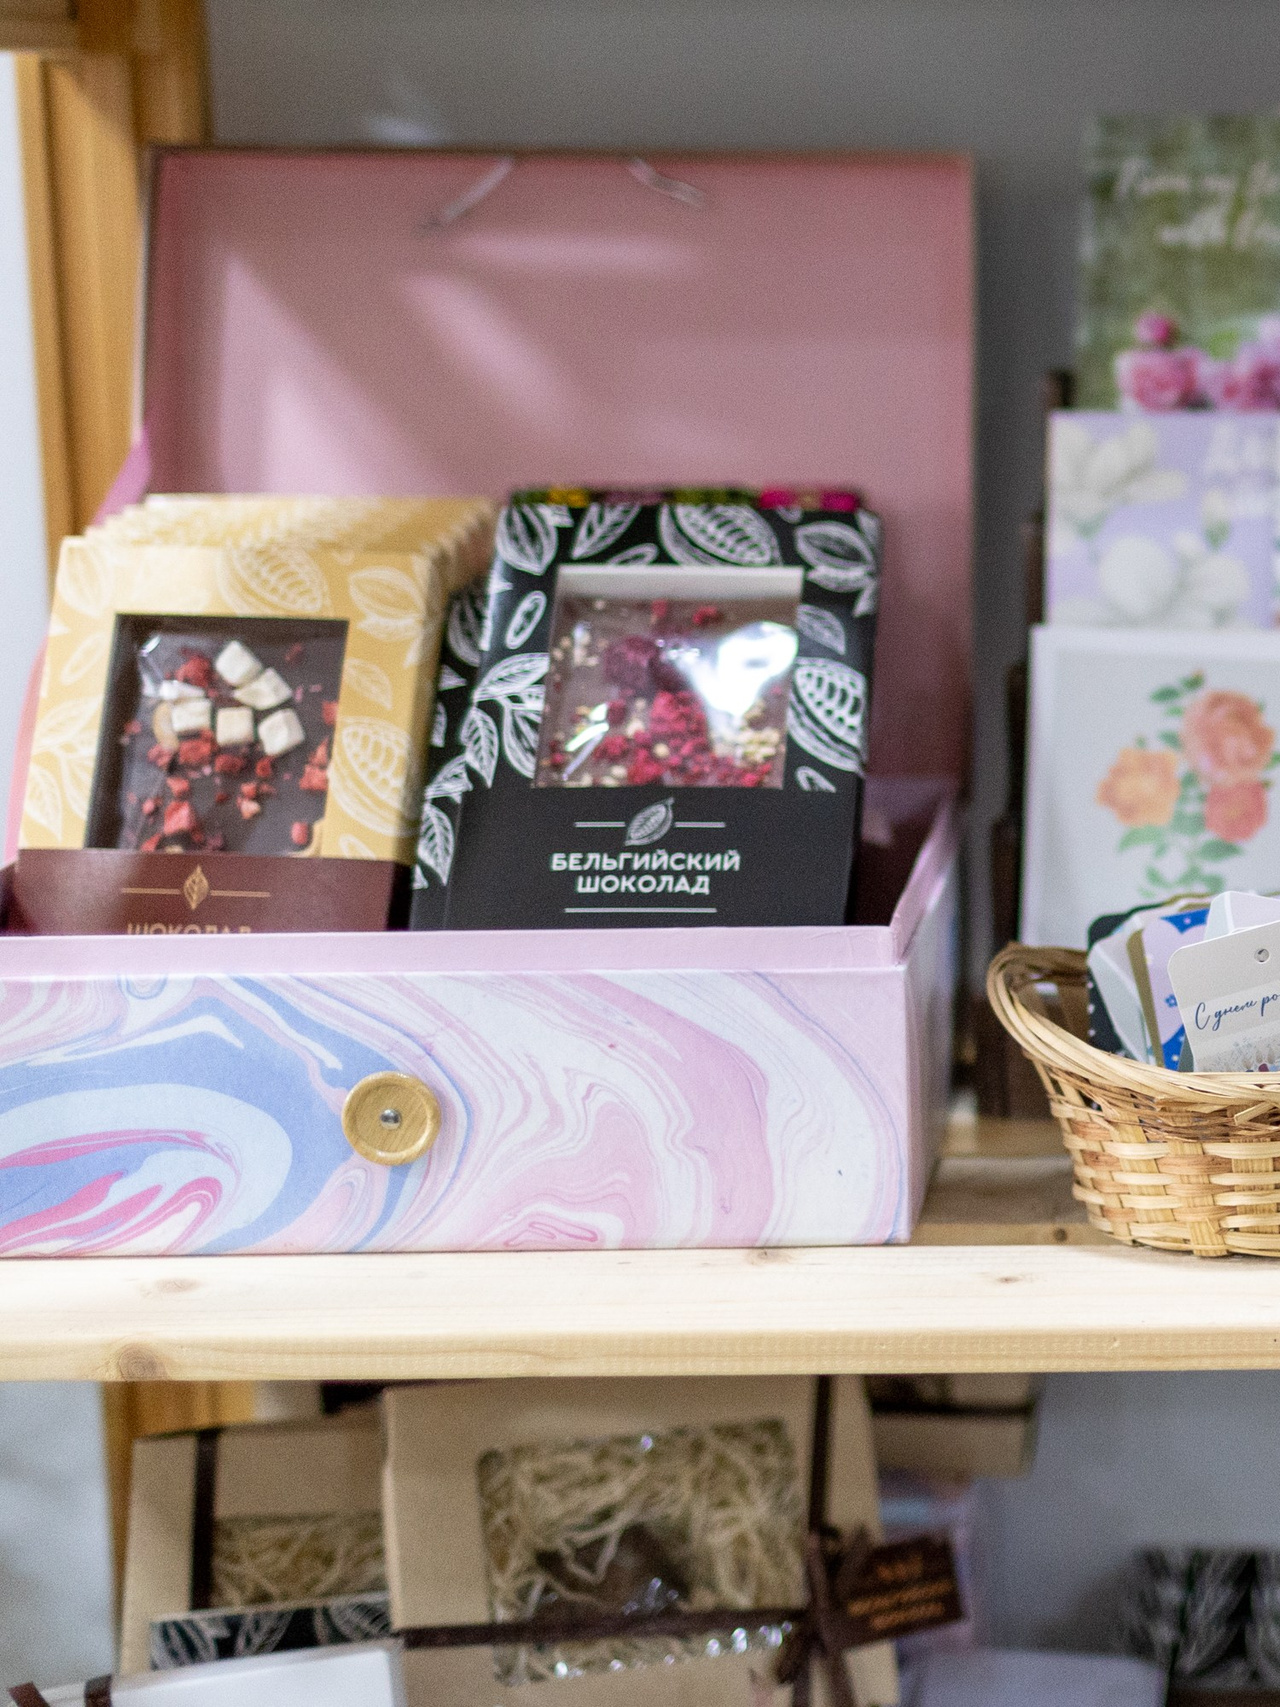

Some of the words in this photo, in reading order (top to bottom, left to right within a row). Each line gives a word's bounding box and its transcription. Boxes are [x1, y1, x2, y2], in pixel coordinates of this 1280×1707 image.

[551, 849, 741, 871] БЕЛЬГИЙСКИЙ
[576, 875, 711, 895] ШОКОЛАД
[1194, 1002, 1211, 1030] С
